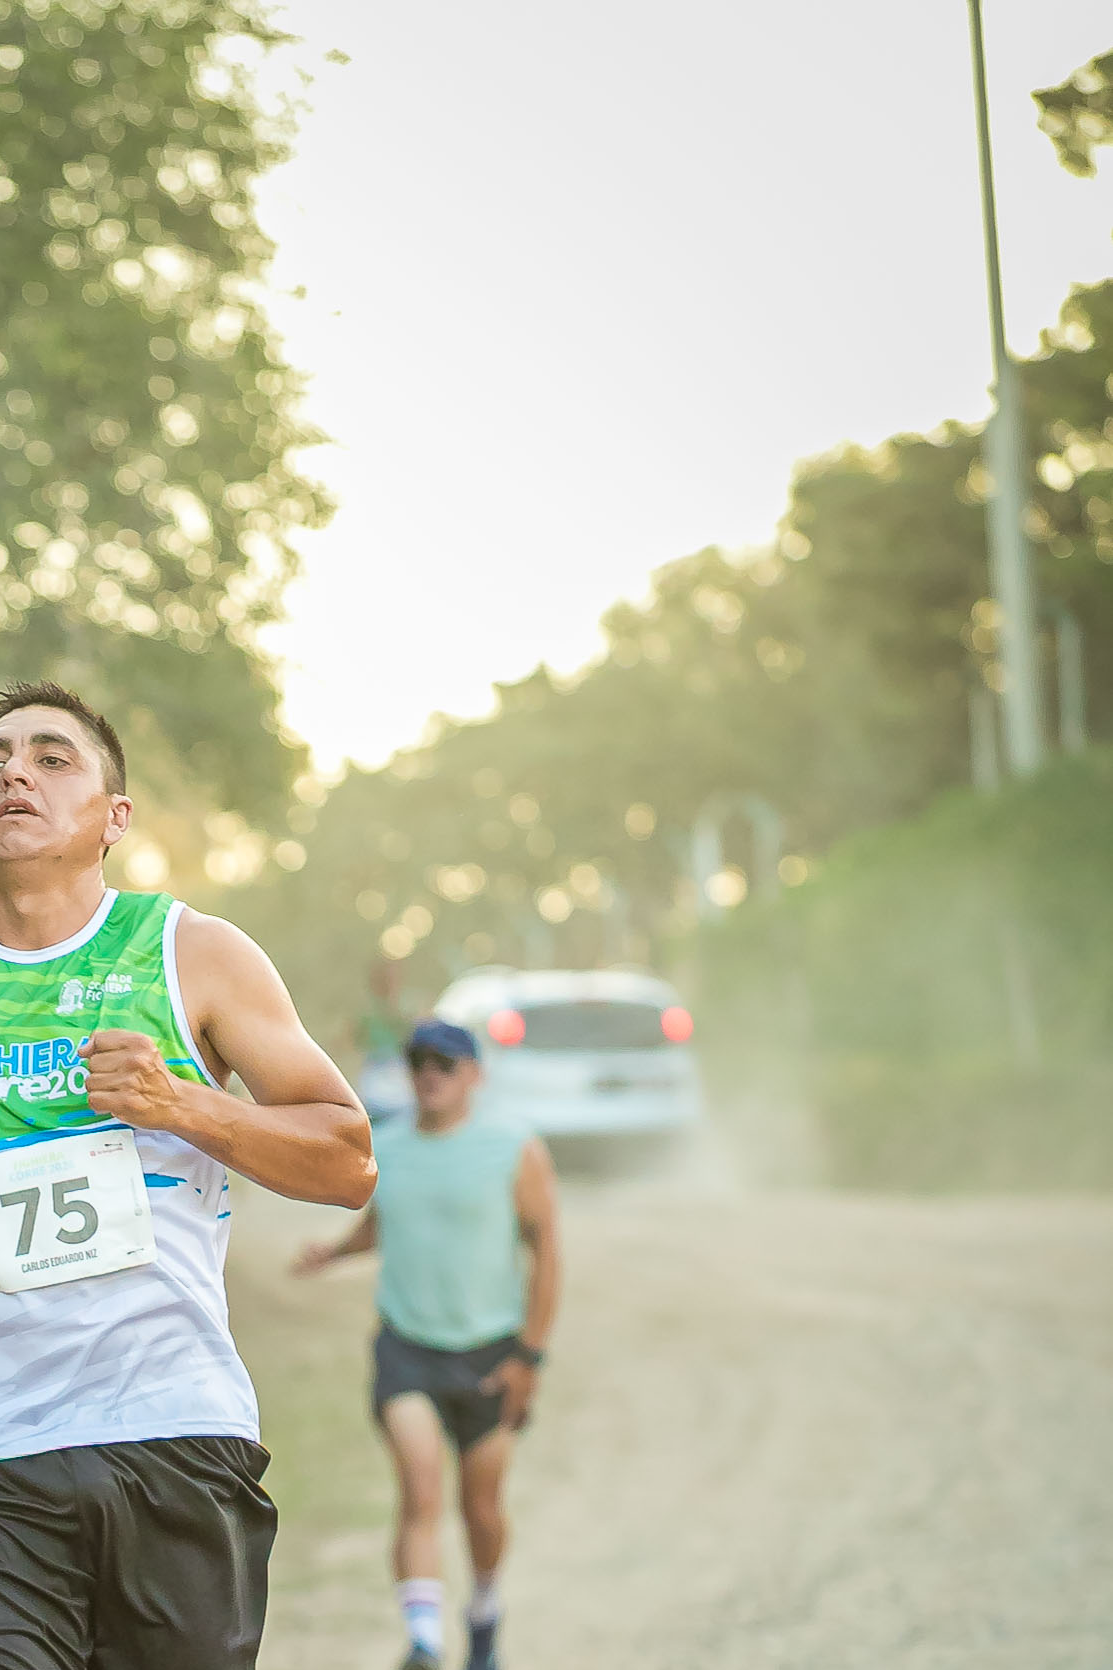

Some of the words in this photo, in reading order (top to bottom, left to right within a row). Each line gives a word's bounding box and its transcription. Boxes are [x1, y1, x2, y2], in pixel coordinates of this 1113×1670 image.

[0, 1176, 99, 1257] 75
[21, 1258, 50, 1274] CARLOS
[50, 1251, 85, 1267] EDUARDO
[85, 1248, 99, 1260] NIZ
